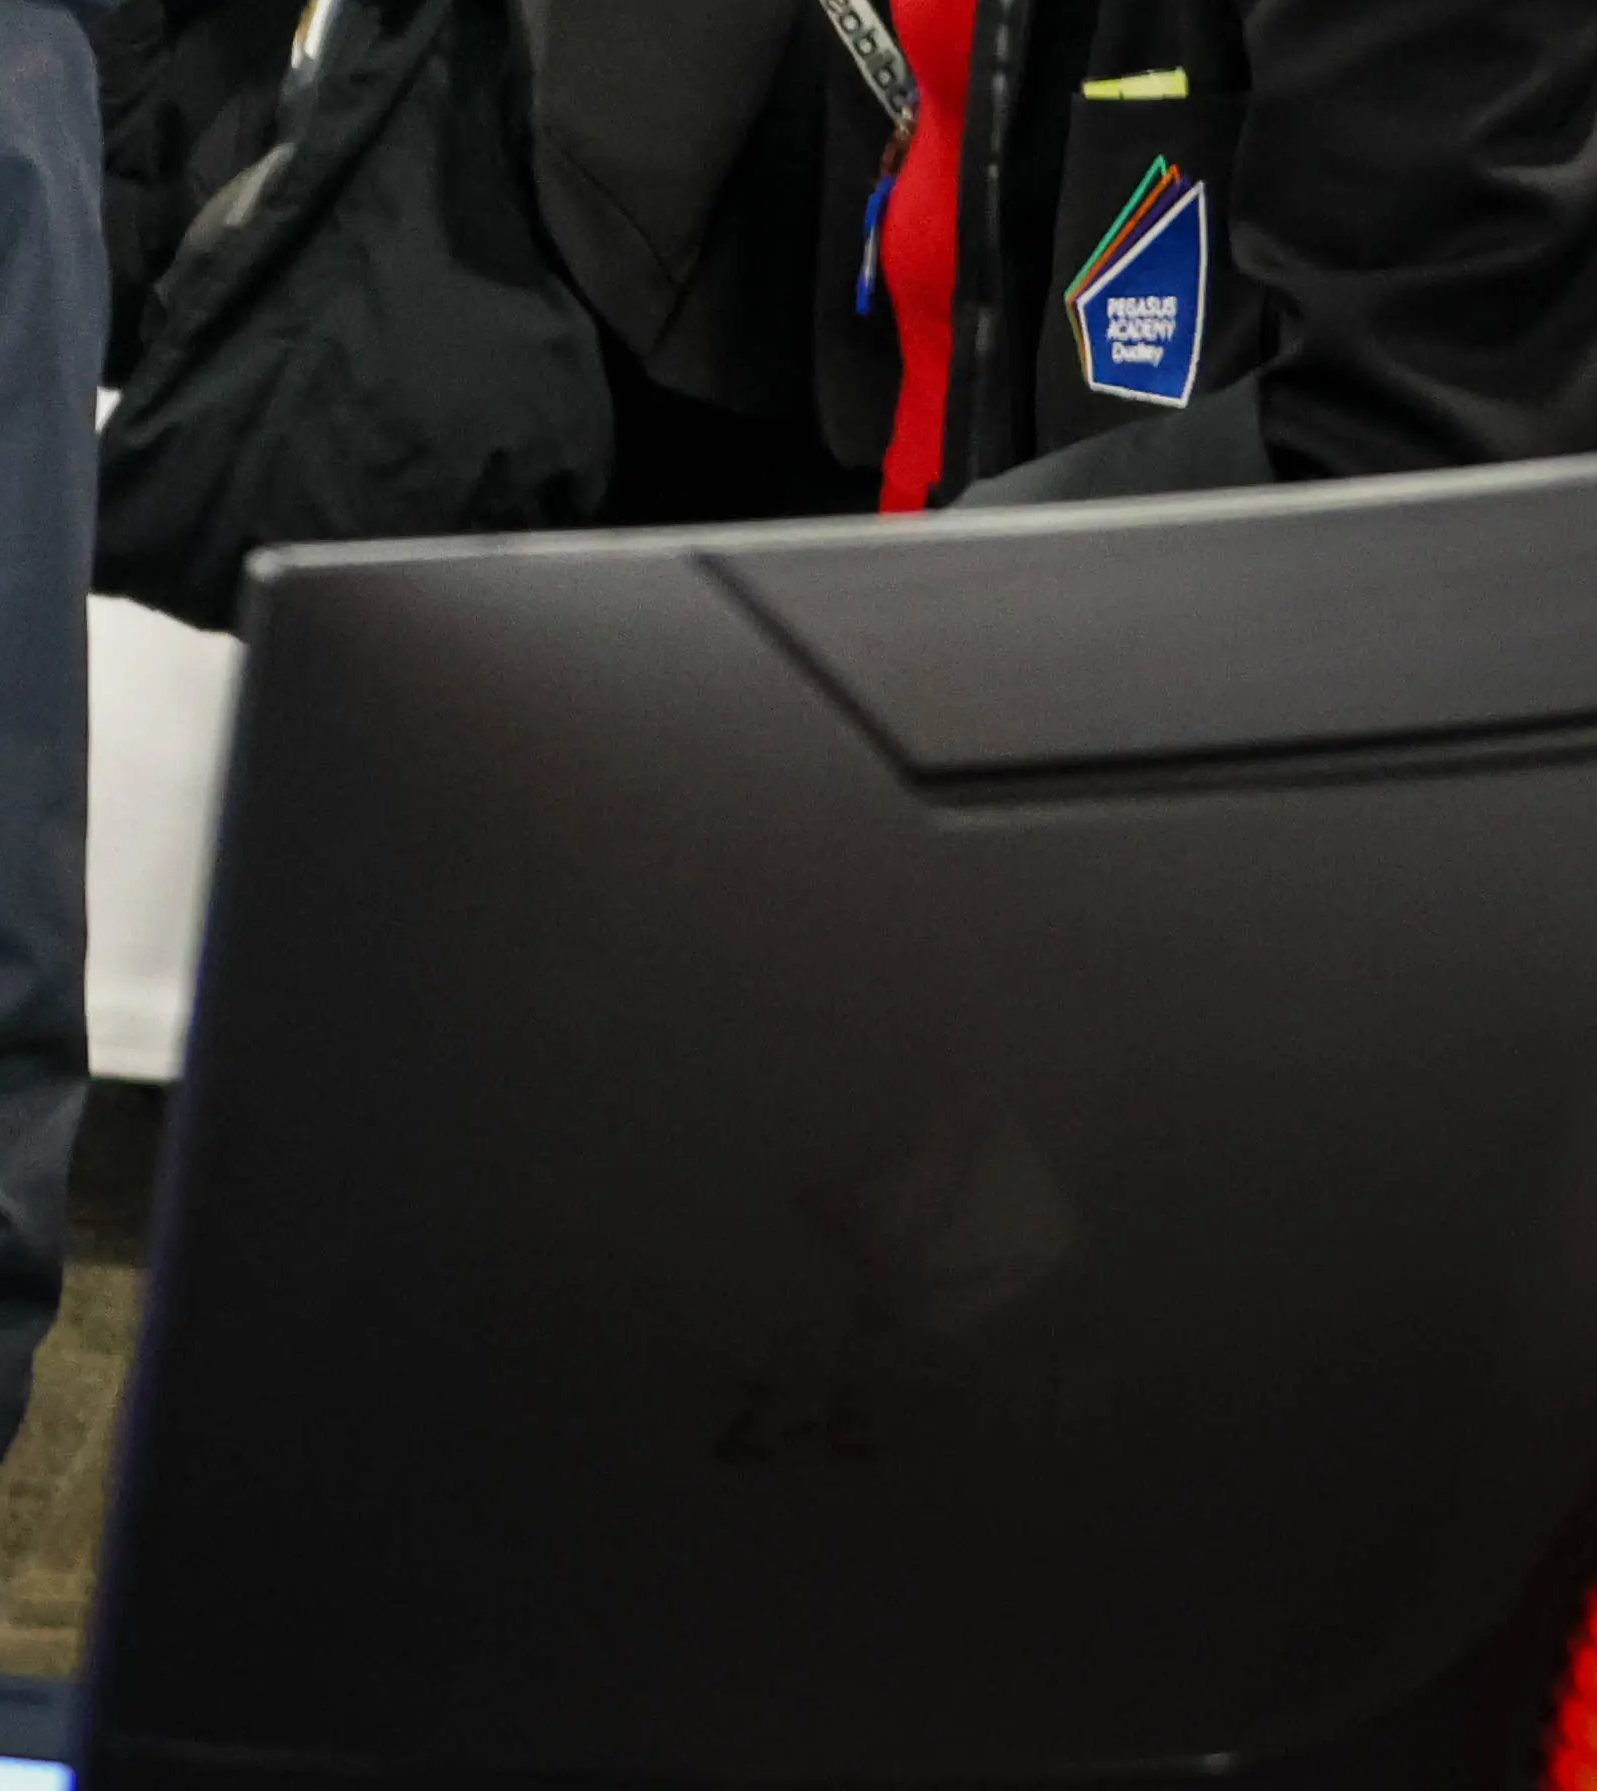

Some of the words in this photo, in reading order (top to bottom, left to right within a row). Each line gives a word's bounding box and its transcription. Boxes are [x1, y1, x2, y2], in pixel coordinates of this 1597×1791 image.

[1106, 295, 1178, 320] PEGASUS
[1106, 317, 1177, 343] ACADEMY
[1111, 341, 1165, 368] Dudley
